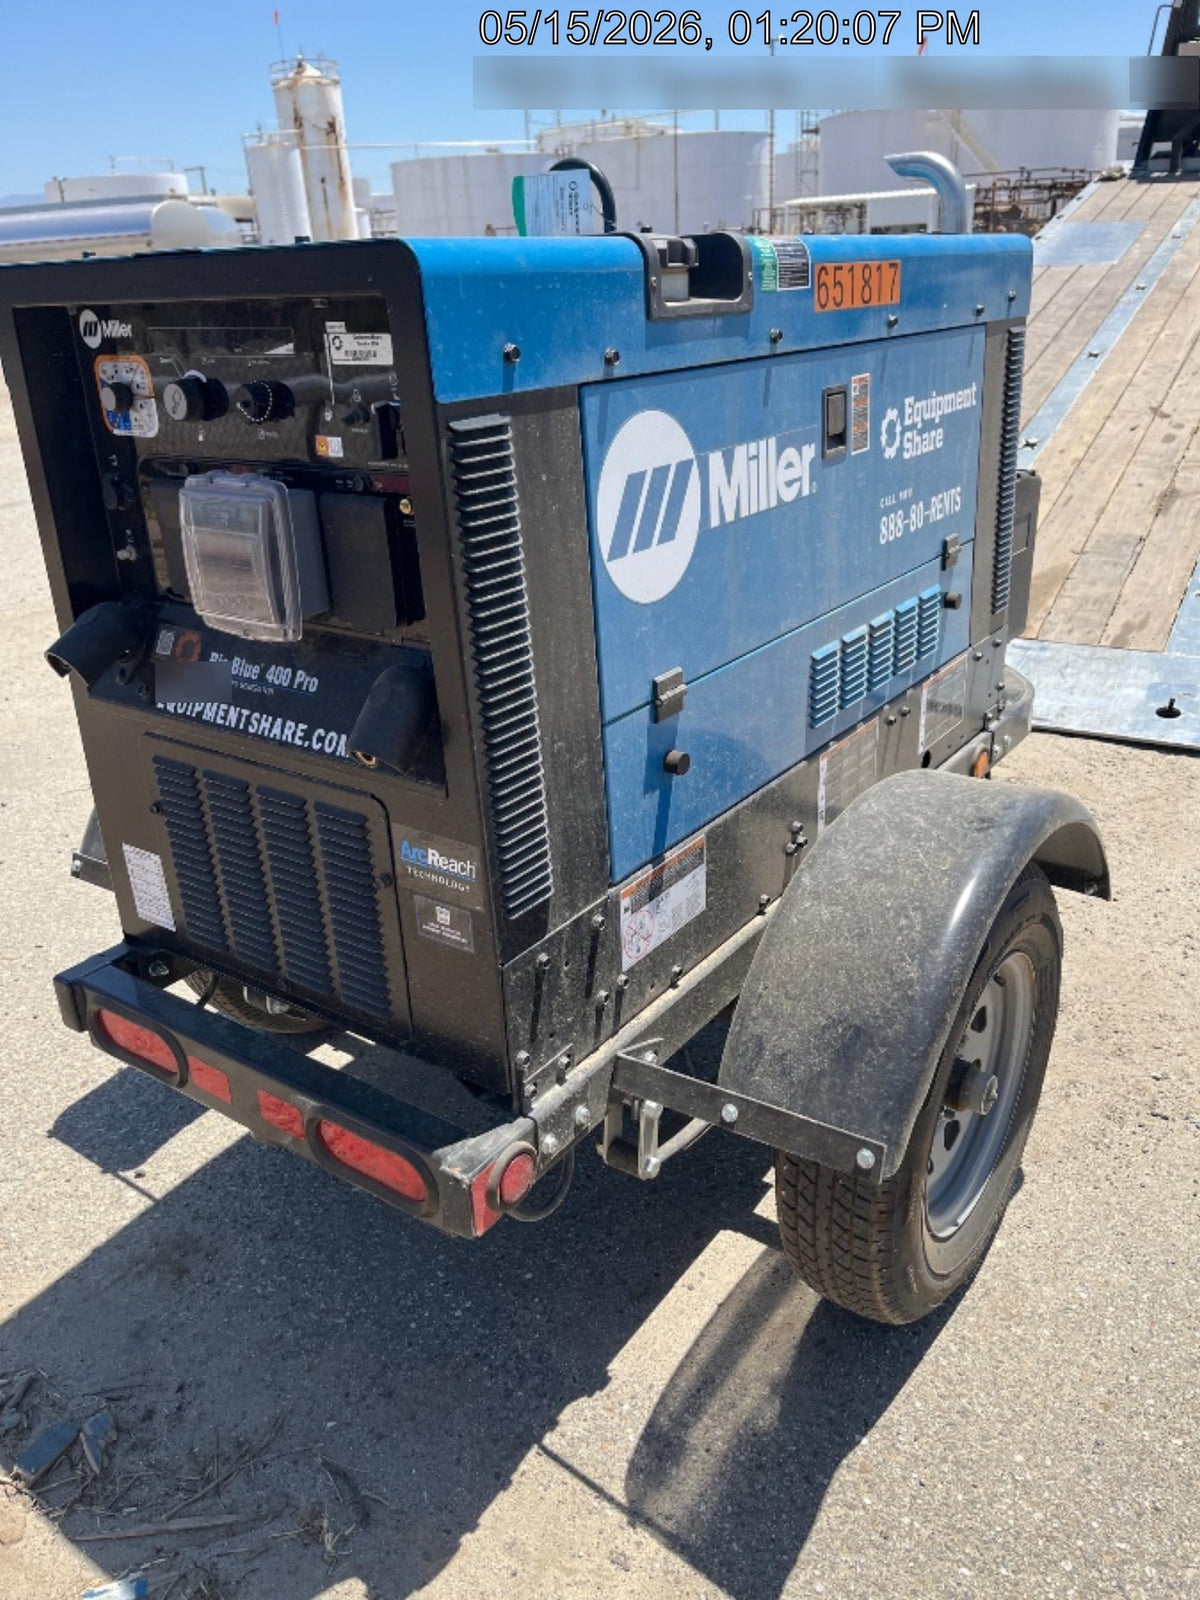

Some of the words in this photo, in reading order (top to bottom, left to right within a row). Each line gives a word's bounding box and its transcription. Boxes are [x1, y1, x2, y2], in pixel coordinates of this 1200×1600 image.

[816, 262, 898, 310] 651817
[102, 319, 132, 339] Miller
[904, 382, 977, 429] Equipment
[903, 427, 943, 460] Share
[709, 438, 815, 529] Miller
[879, 486, 962, 545] 888-80-RENTS
[231, 656, 261, 680] Blue
[266, 664, 292, 688] 400
[293, 669, 319, 693] Pro
[401, 840, 476, 879] ArcReach
